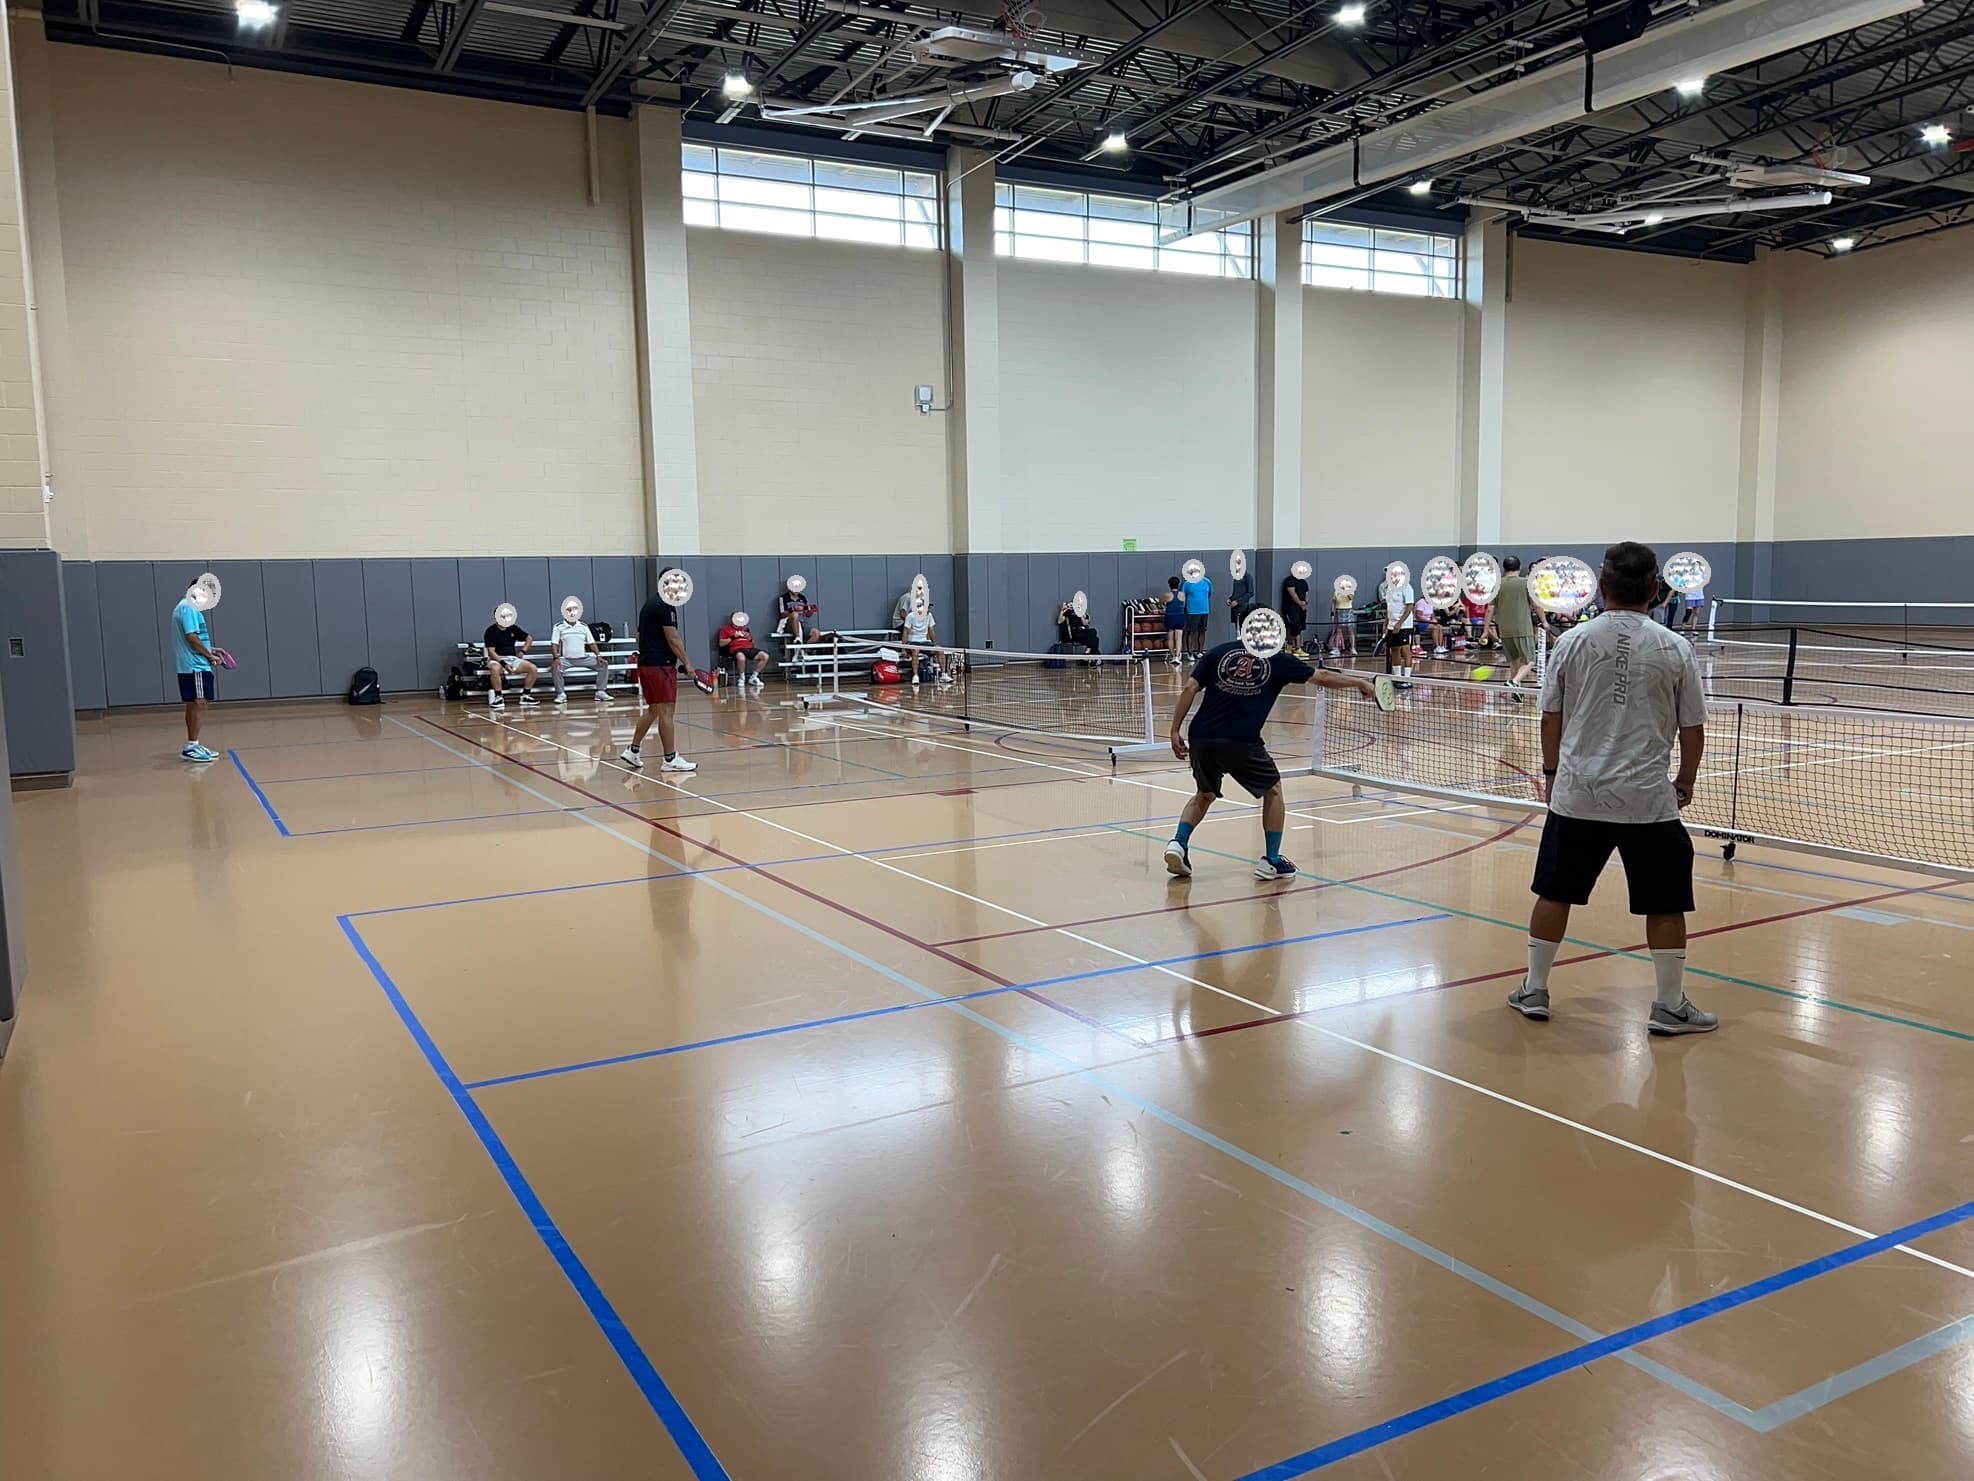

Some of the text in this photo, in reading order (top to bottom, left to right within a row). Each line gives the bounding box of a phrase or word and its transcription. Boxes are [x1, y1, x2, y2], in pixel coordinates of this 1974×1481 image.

[1613, 633, 1631, 705] NIKE PRO
[1704, 829, 1755, 844] DOMINATOR
